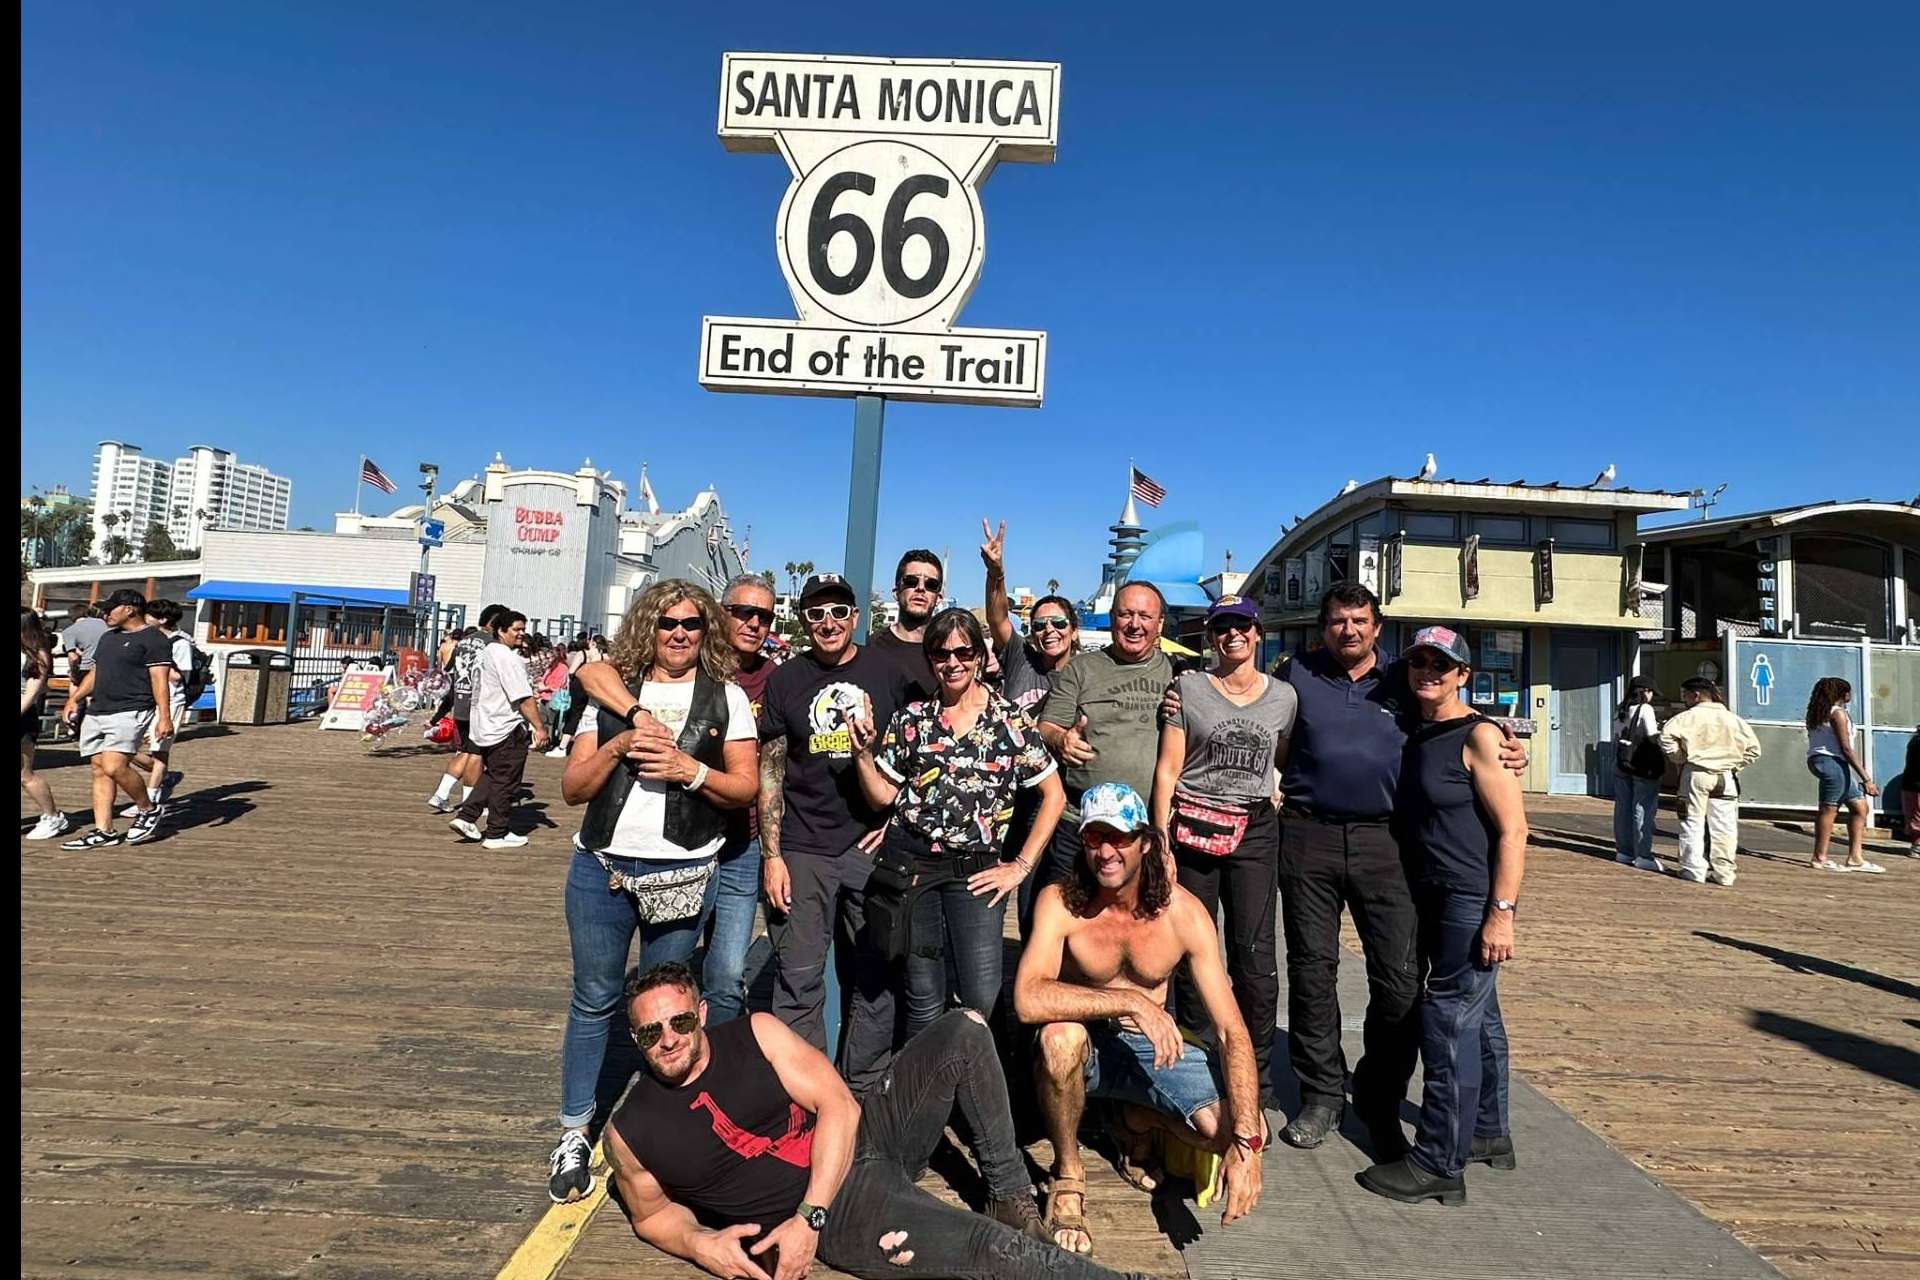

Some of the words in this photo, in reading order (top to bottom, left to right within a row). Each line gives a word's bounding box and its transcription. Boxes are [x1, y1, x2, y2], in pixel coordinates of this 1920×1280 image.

[735, 70, 860, 119] SANTA
[878, 78, 1042, 126] MONICA
[808, 171, 950, 299] 66
[720, 333, 794, 373] End
[808, 335, 851, 376] of
[864, 338, 925, 380] the
[940, 344, 1025, 385] Trail
[515, 508, 563, 525] BUBBA
[518, 526, 560, 542] GUMP
[1211, 742, 1253, 769] ROUTE
[1253, 750, 1269, 774] 66
